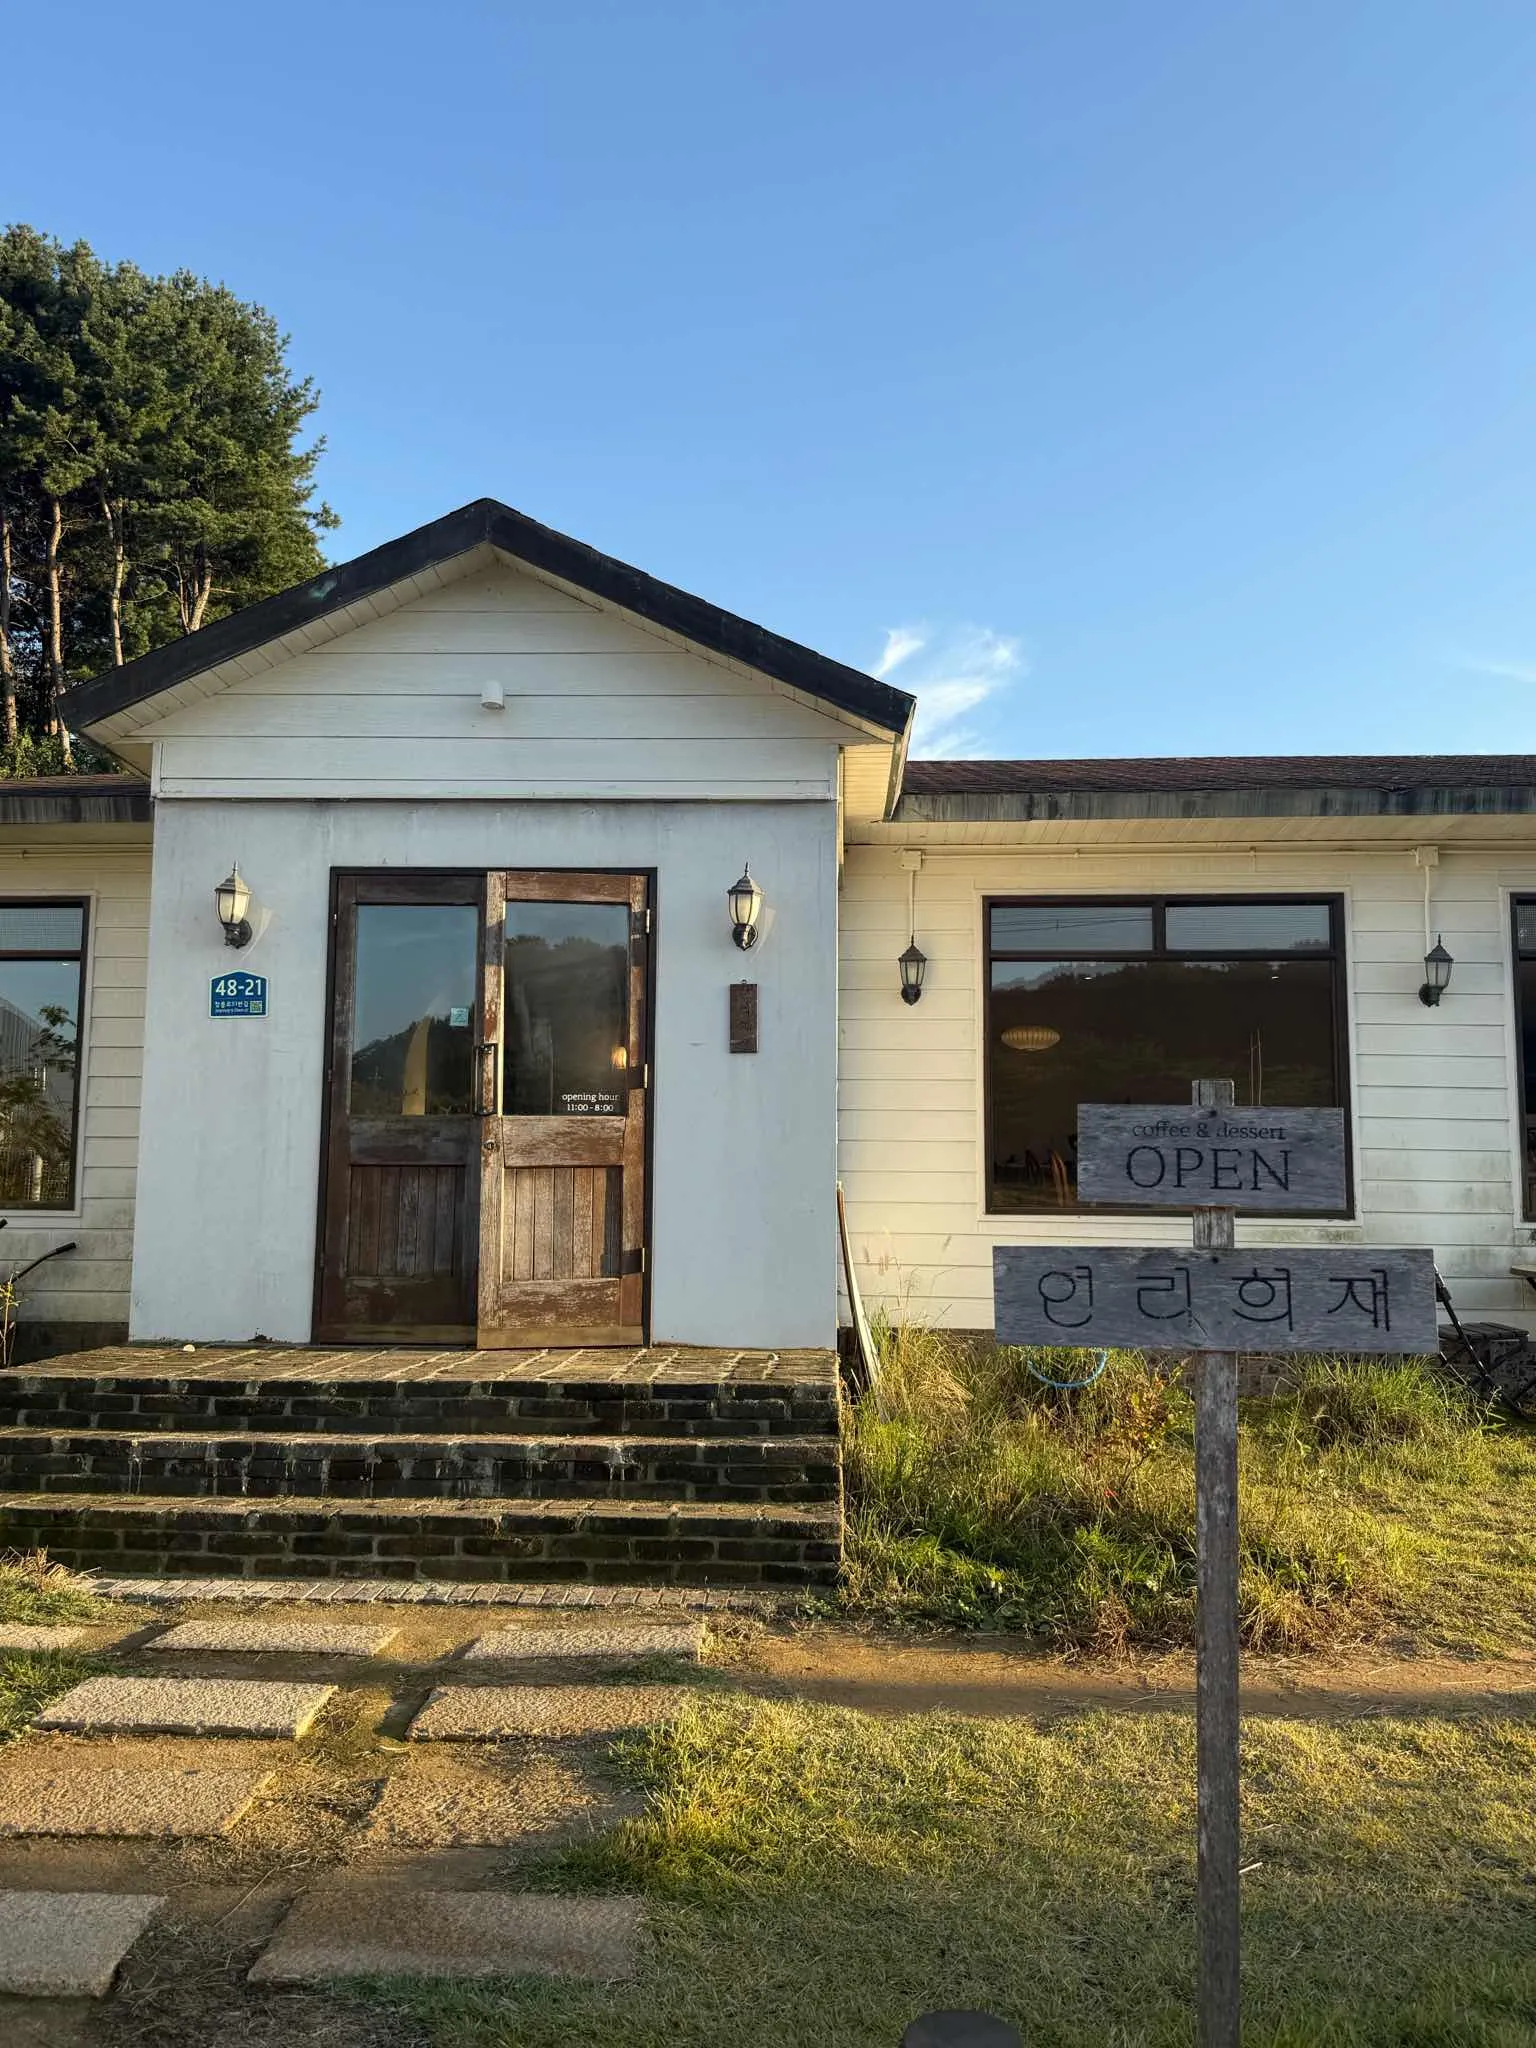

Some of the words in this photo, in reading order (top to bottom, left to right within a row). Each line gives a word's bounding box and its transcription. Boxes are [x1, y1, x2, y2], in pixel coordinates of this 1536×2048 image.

[215, 979, 262, 996] 48-21
[562, 1092, 597, 1103] opening
[595, 1104, 614, 1112] 8:00
[1133, 1120, 1191, 1138] coffee
[1196, 1122, 1211, 1138] &
[1216, 1122, 1288, 1140] dessert
[1126, 1145, 1293, 1192] OPEN
